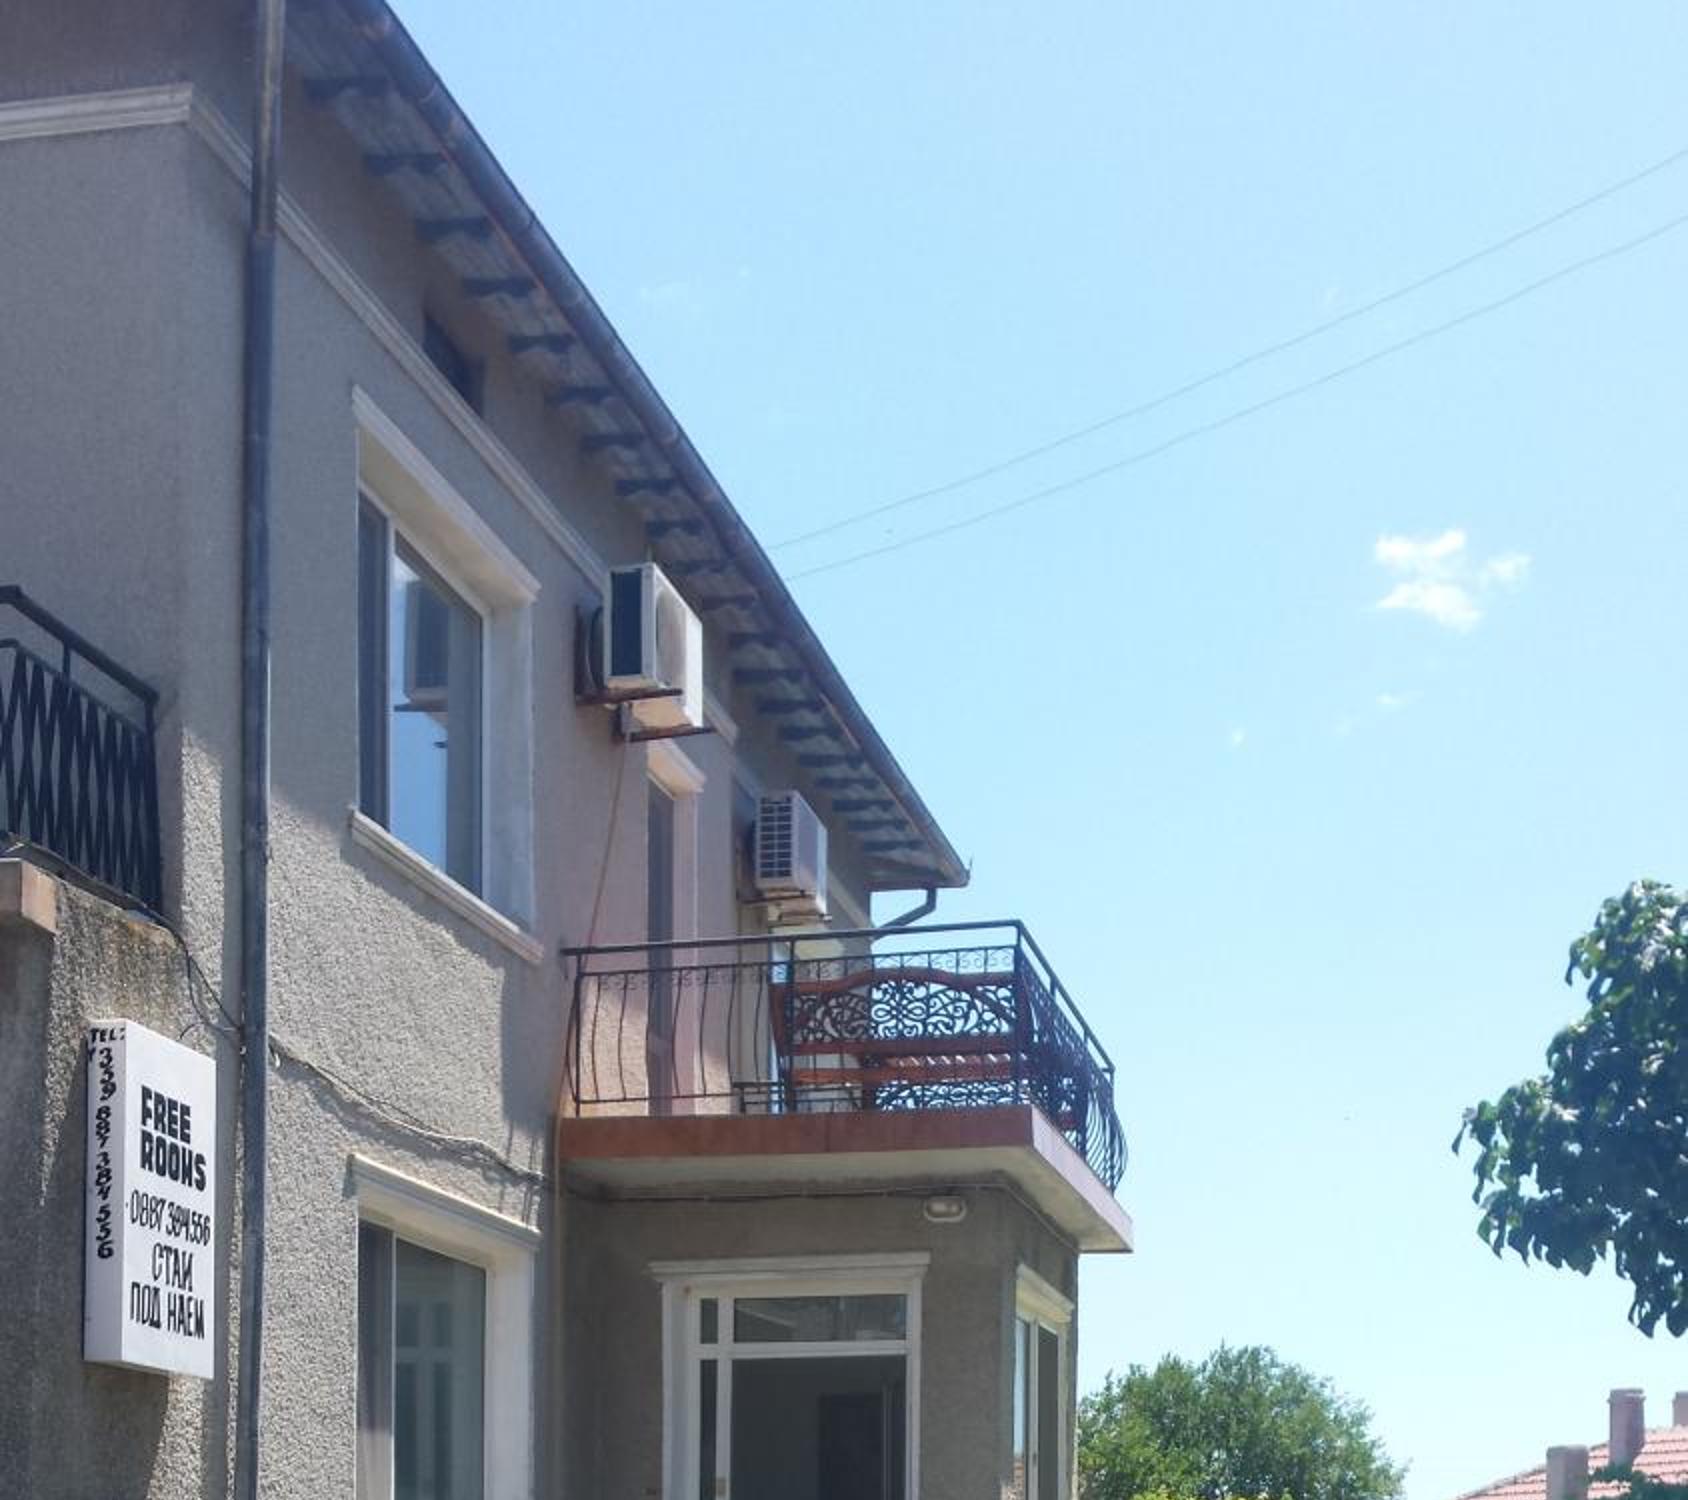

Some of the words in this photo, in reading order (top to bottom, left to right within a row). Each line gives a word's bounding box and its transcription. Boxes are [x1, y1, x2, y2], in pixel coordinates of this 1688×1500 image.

[89, 1027, 125, 1043] TEL:
[141, 1084, 191, 1145] FREE
[152, 1242, 194, 1292] СТАИ
[130, 1281, 162, 1329] ПОД
[167, 1292, 205, 1339] НАЕМ
